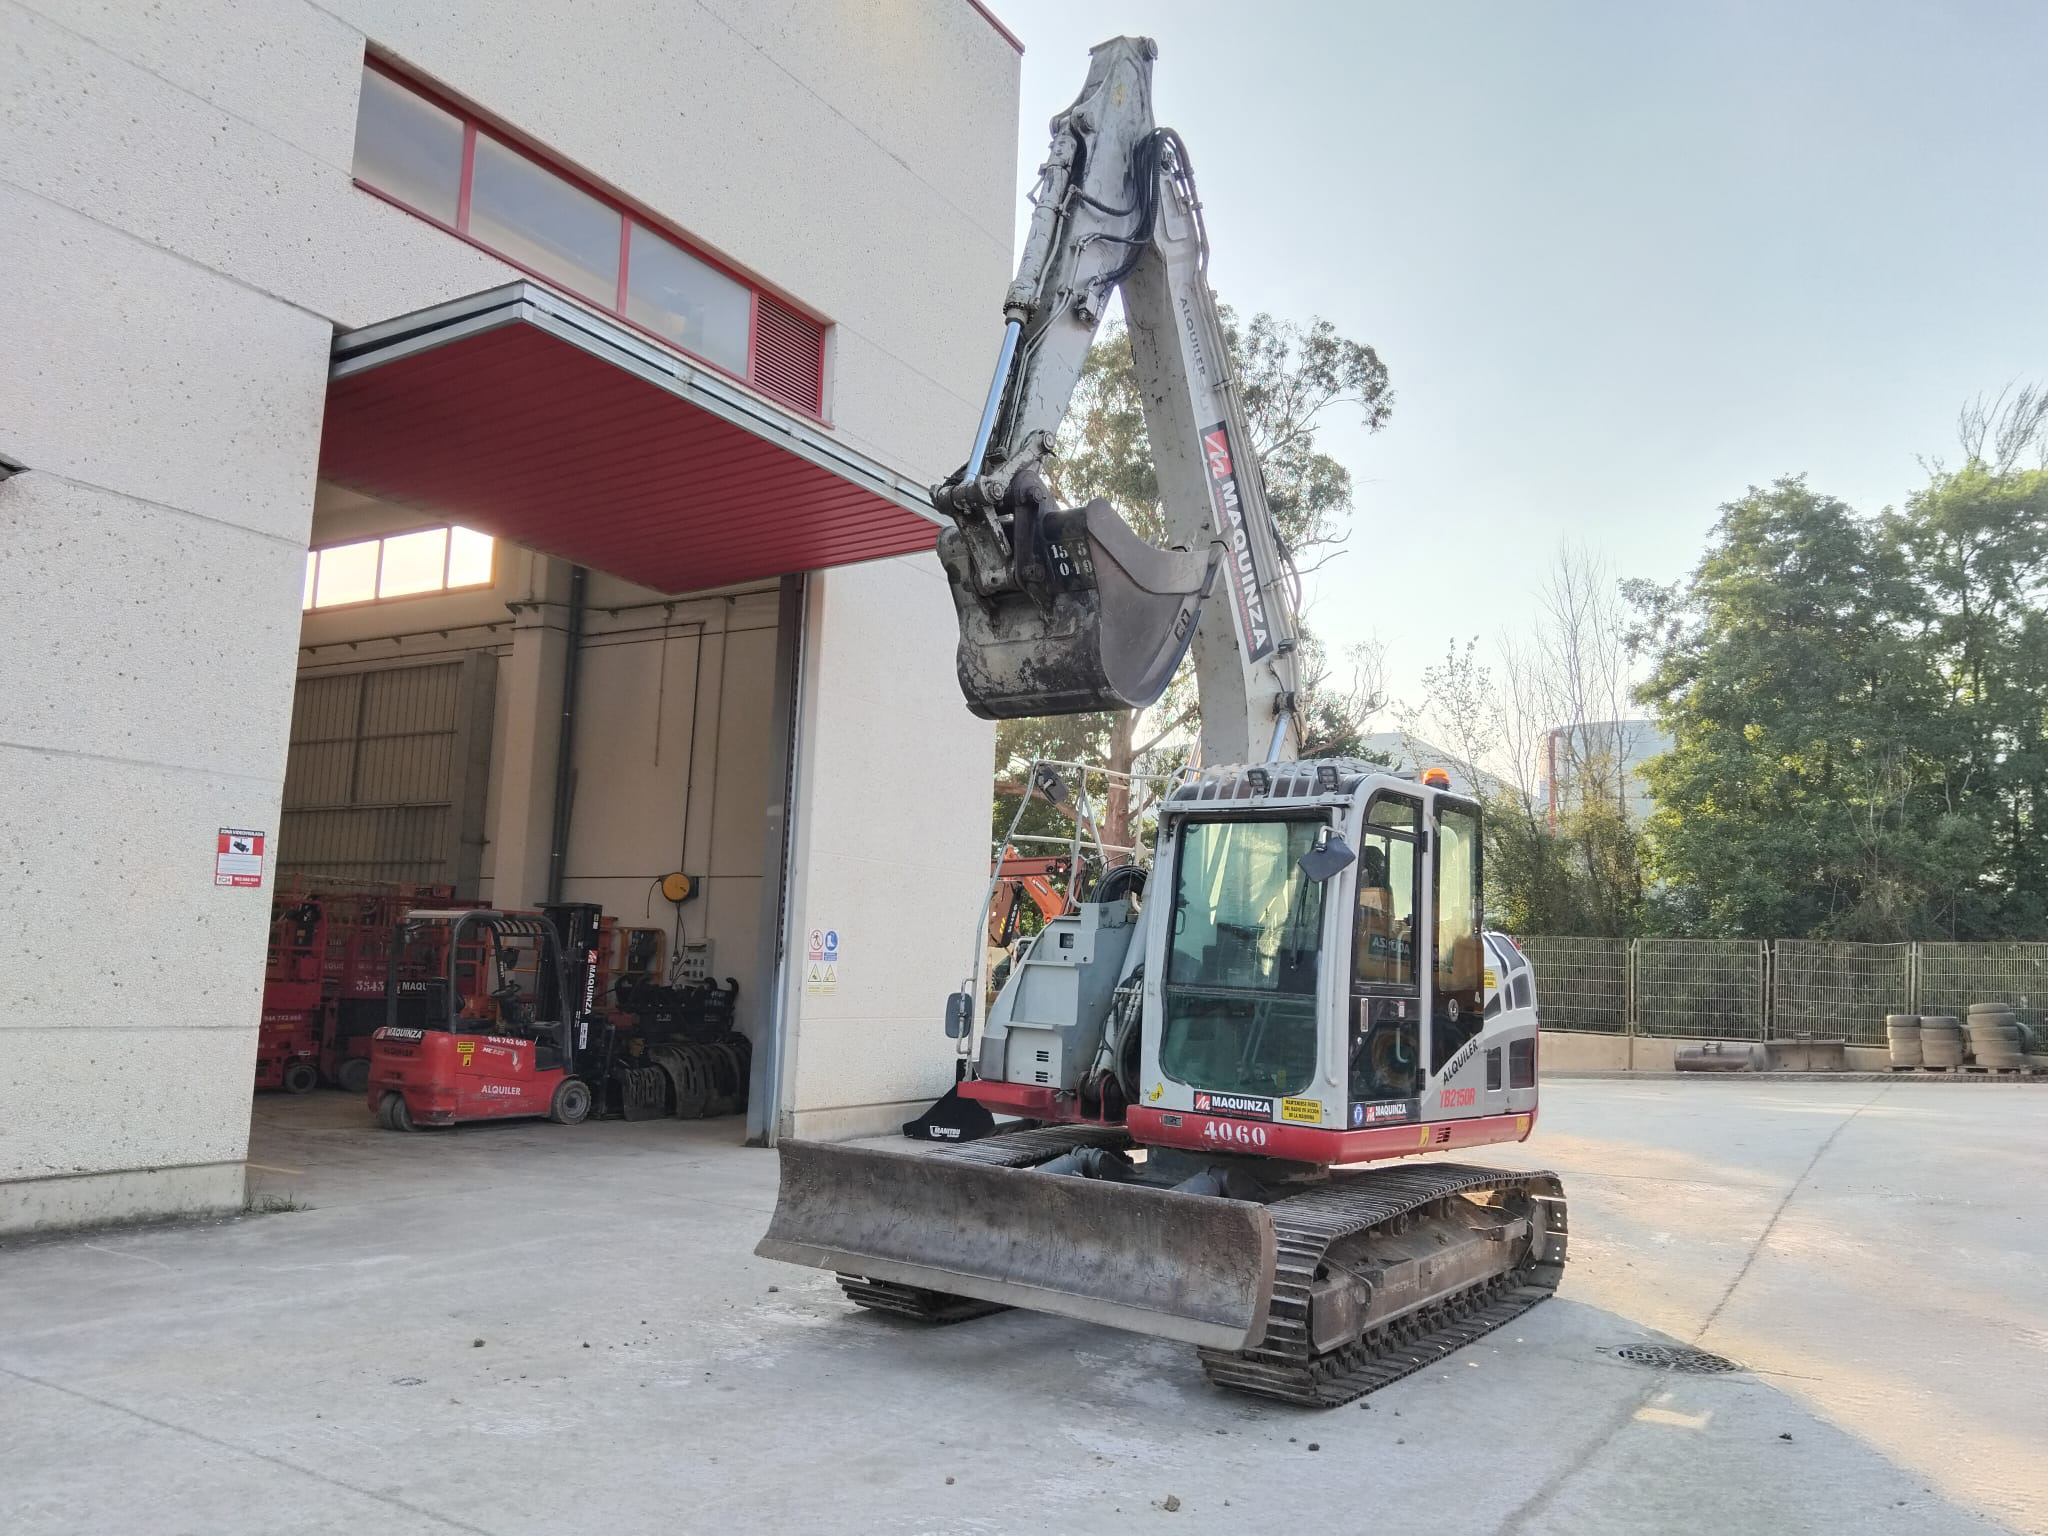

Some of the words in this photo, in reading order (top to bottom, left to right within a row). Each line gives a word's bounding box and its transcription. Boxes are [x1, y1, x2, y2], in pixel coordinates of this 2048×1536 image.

[1180, 297, 1206, 376] ALQUILER
[1222, 480, 1267, 650] MAQUINZA
[584, 964, 596, 1015] MAQUINZA
[387, 1027, 422, 1039] MAQUINZA
[1443, 1038, 1479, 1085] ALQUILER
[481, 1085, 521, 1095] ALQUILER
[1212, 1096, 1271, 1113] MAQUINZA
[1376, 1103, 1407, 1116] MAQUINZA
[1204, 1120, 1267, 1146] 4060
